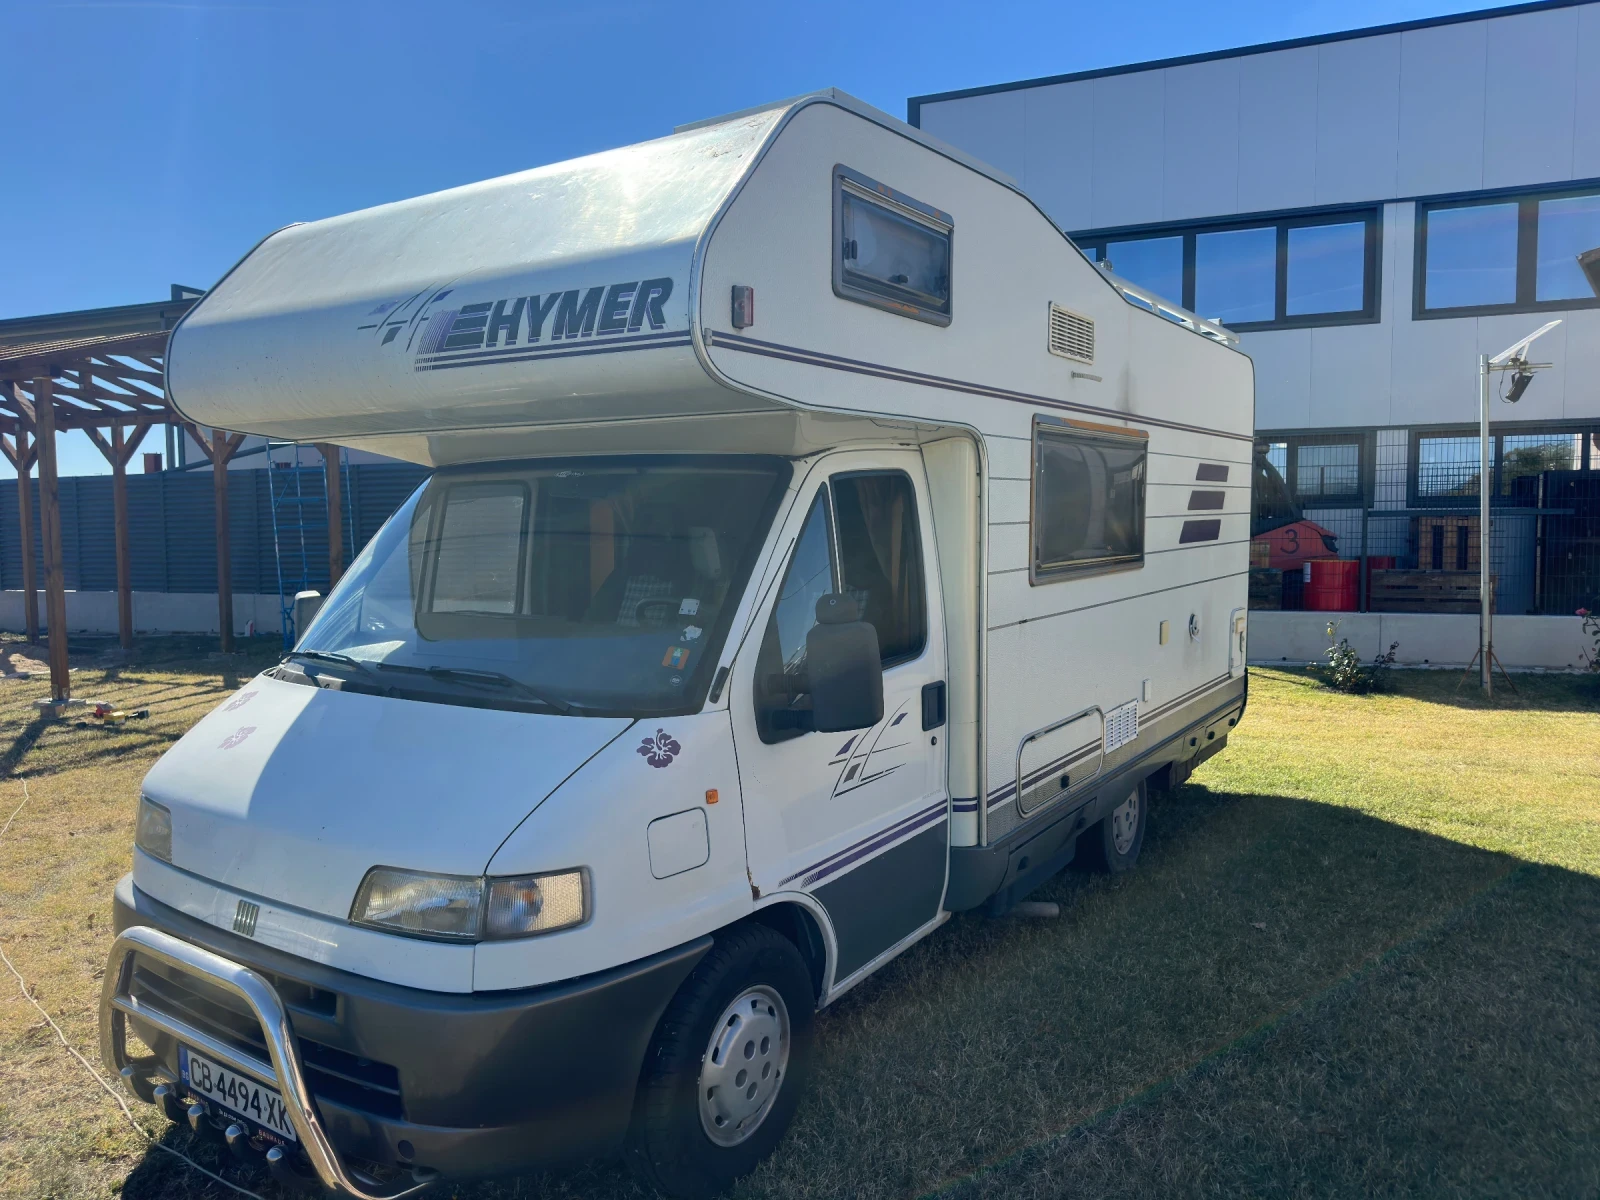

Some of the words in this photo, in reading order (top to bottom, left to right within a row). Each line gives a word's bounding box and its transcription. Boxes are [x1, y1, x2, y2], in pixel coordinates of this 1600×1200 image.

[485, 277, 674, 348] HYMER
[1280, 529, 1299, 554] 3
[217, 1072, 262, 1120] 4494
